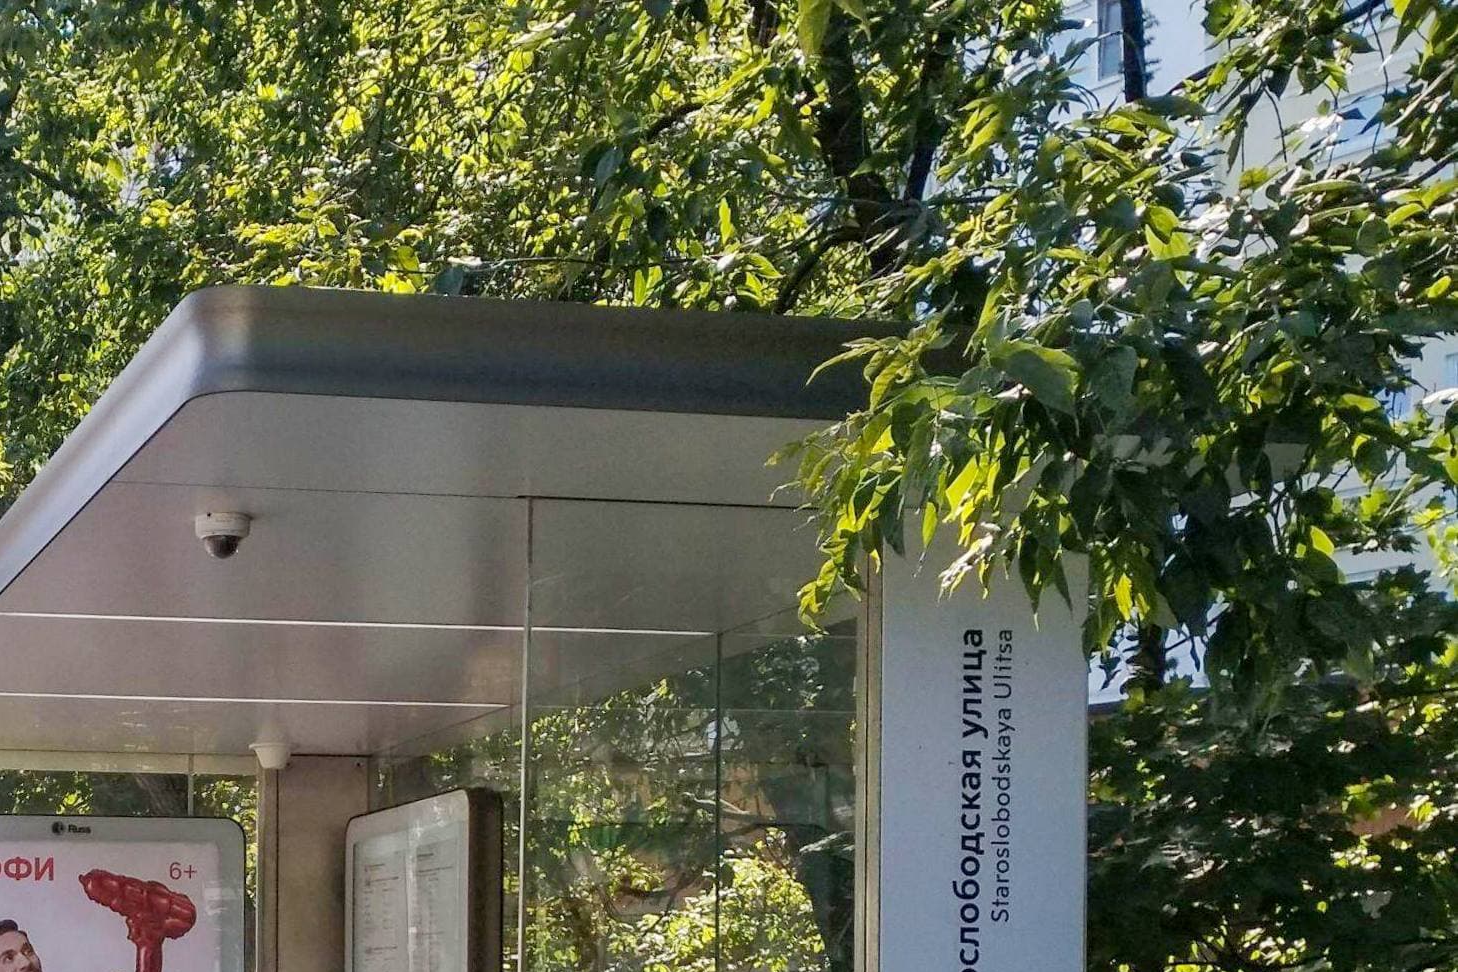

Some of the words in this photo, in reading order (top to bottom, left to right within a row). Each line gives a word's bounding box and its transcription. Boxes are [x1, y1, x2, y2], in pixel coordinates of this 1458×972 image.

[962, 629, 988, 739] улица
[993, 629, 1013, 699] Ulitsa
[991, 707, 1015, 923] Staroslobodskaya
[169, 861, 198, 880] 6+
